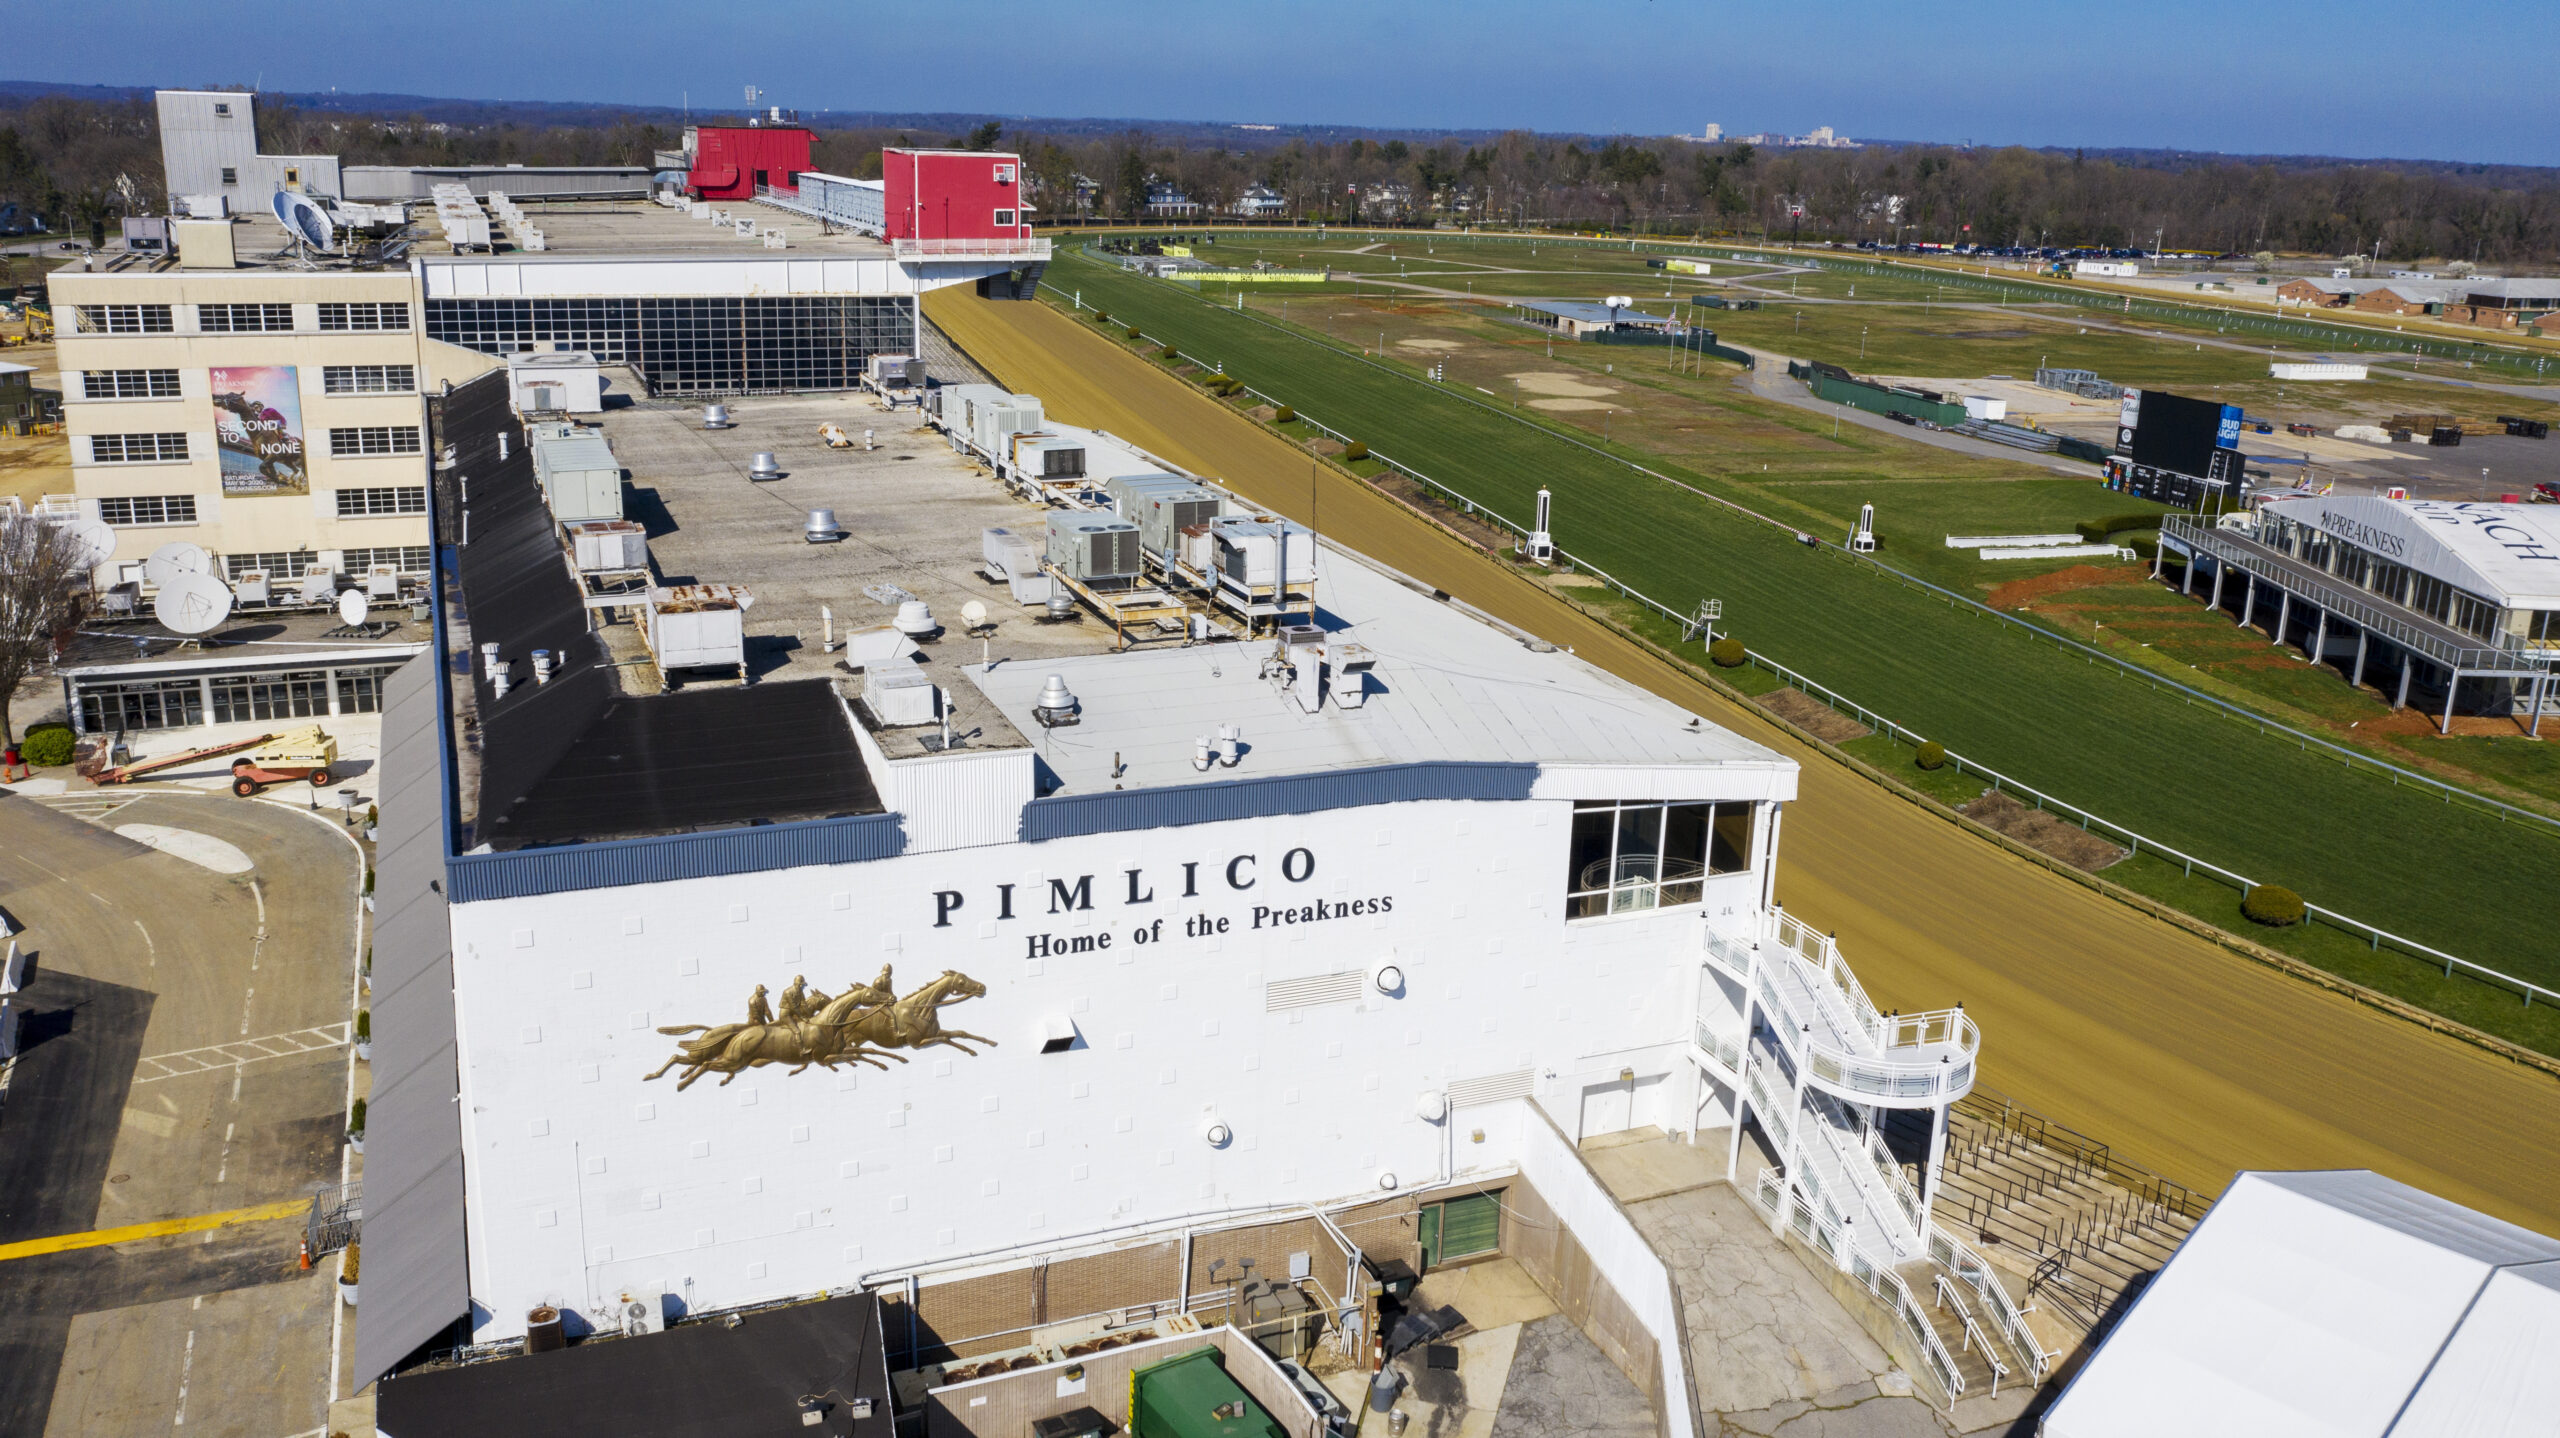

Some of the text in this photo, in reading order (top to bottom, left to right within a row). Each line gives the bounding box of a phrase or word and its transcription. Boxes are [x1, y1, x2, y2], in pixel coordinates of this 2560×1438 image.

[219, 420, 278, 431] SECOND
[2221, 418, 2240, 430] BUD
[220, 432, 240, 443] TO
[260, 443, 302, 454] NONE
[2330, 513, 2405, 558] PREAKNESS
[931, 847, 1316, 929] PIMLICO
[1027, 896, 1393, 960] Home of the Preakness
